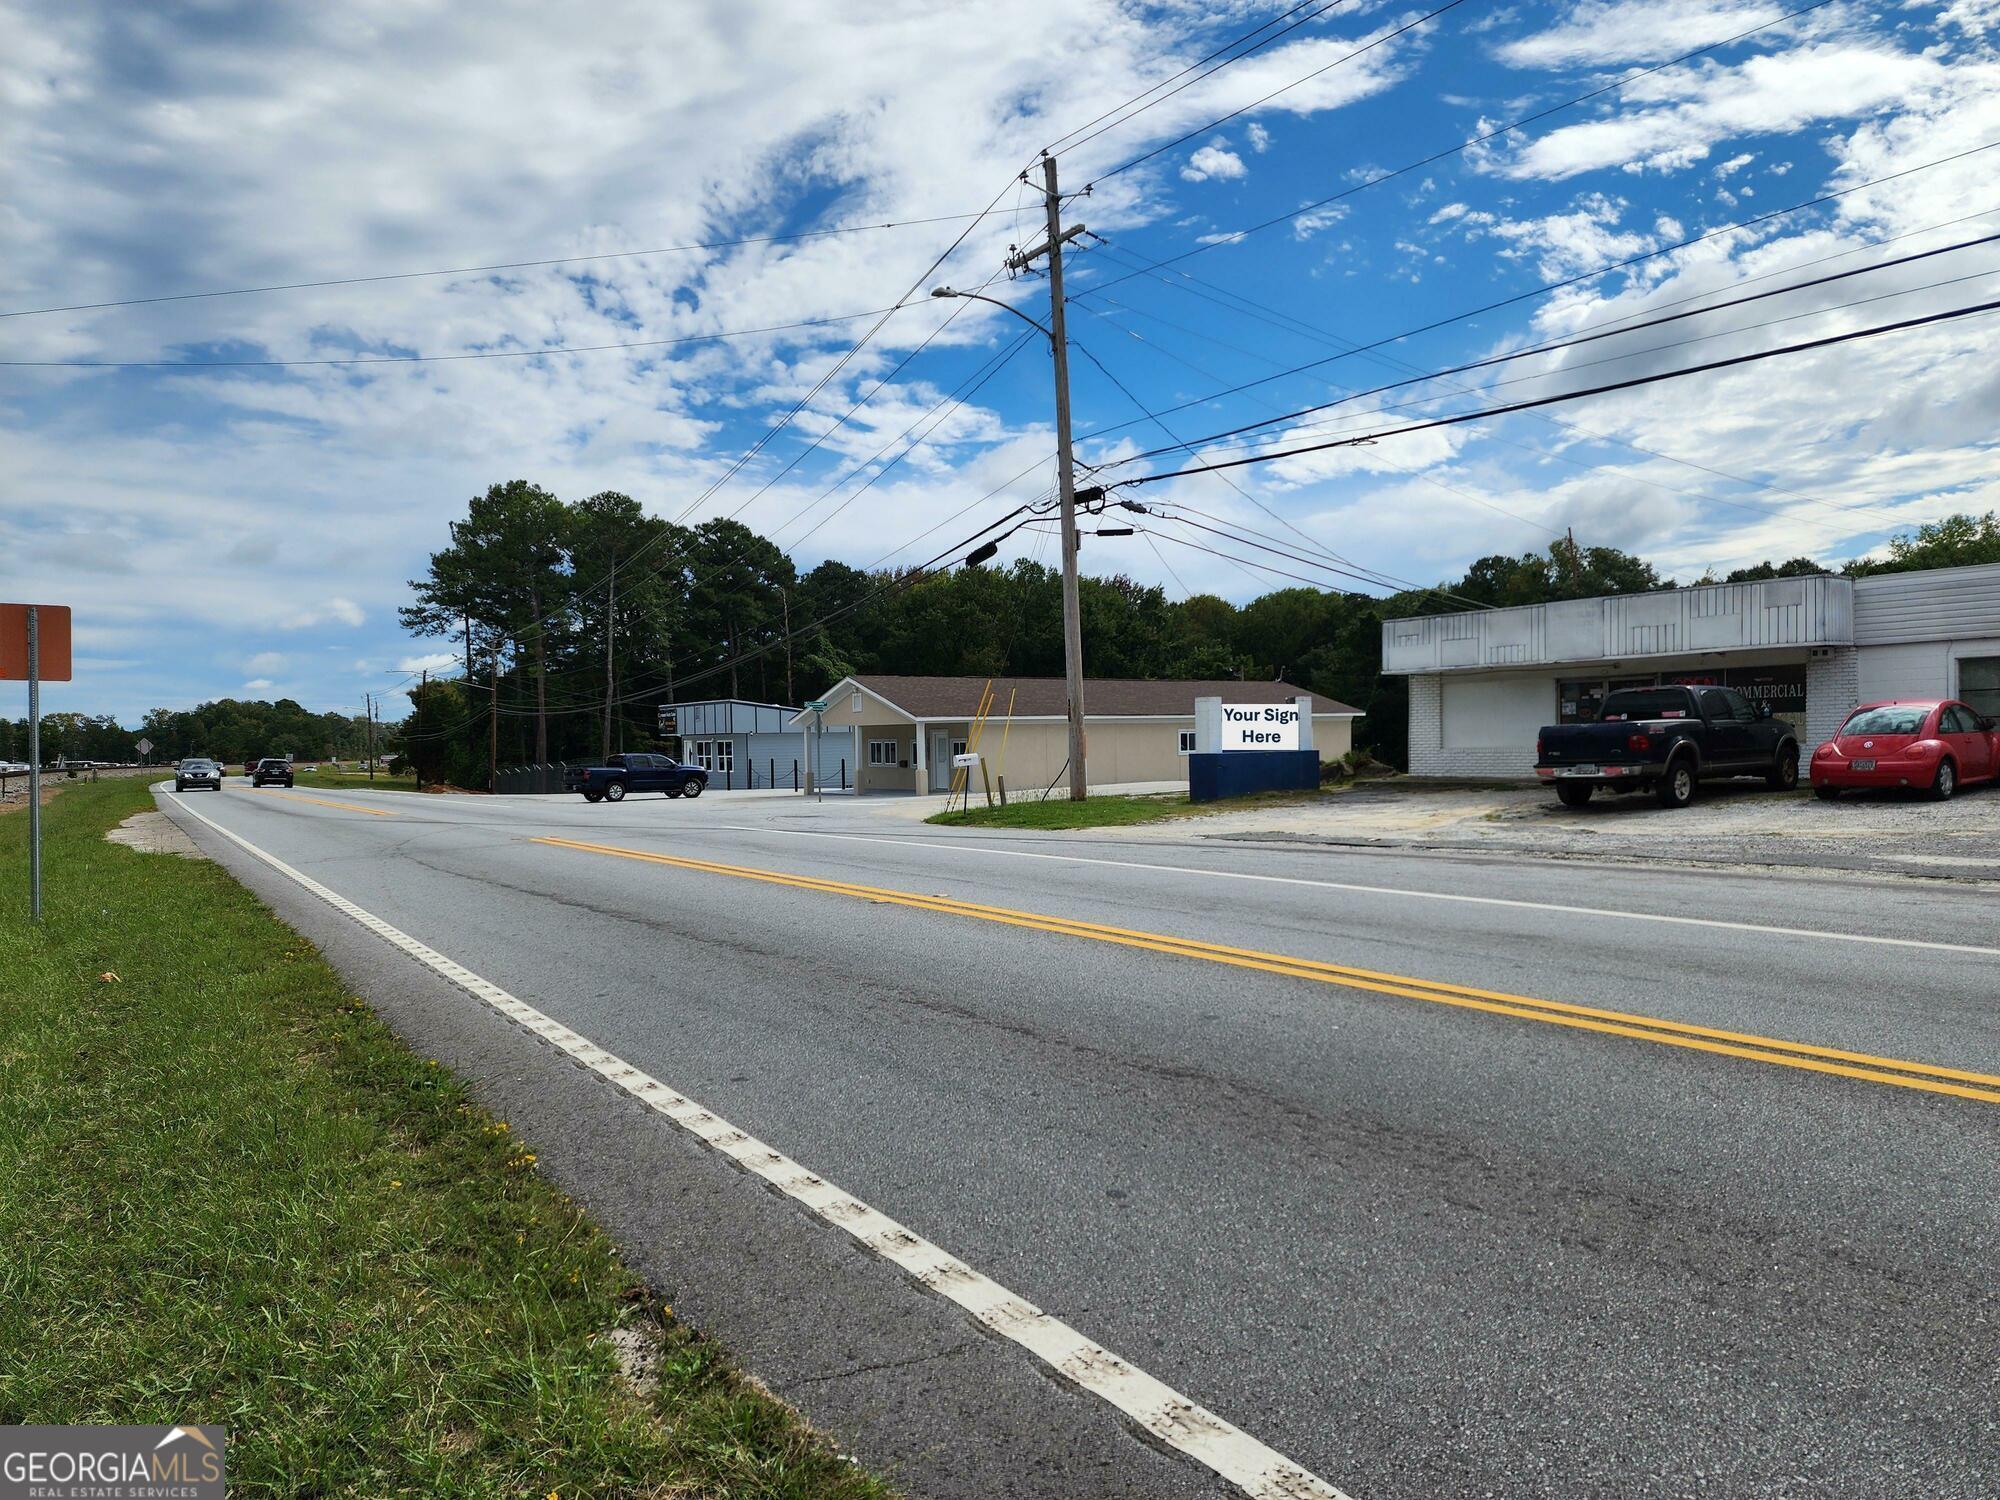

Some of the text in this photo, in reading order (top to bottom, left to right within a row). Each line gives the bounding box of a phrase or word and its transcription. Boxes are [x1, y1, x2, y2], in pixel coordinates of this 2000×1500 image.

[1730, 684, 1803, 699] OMMERCIAL
[1223, 708, 1299, 724] Your Sign
[1242, 730, 1281, 743] Here
